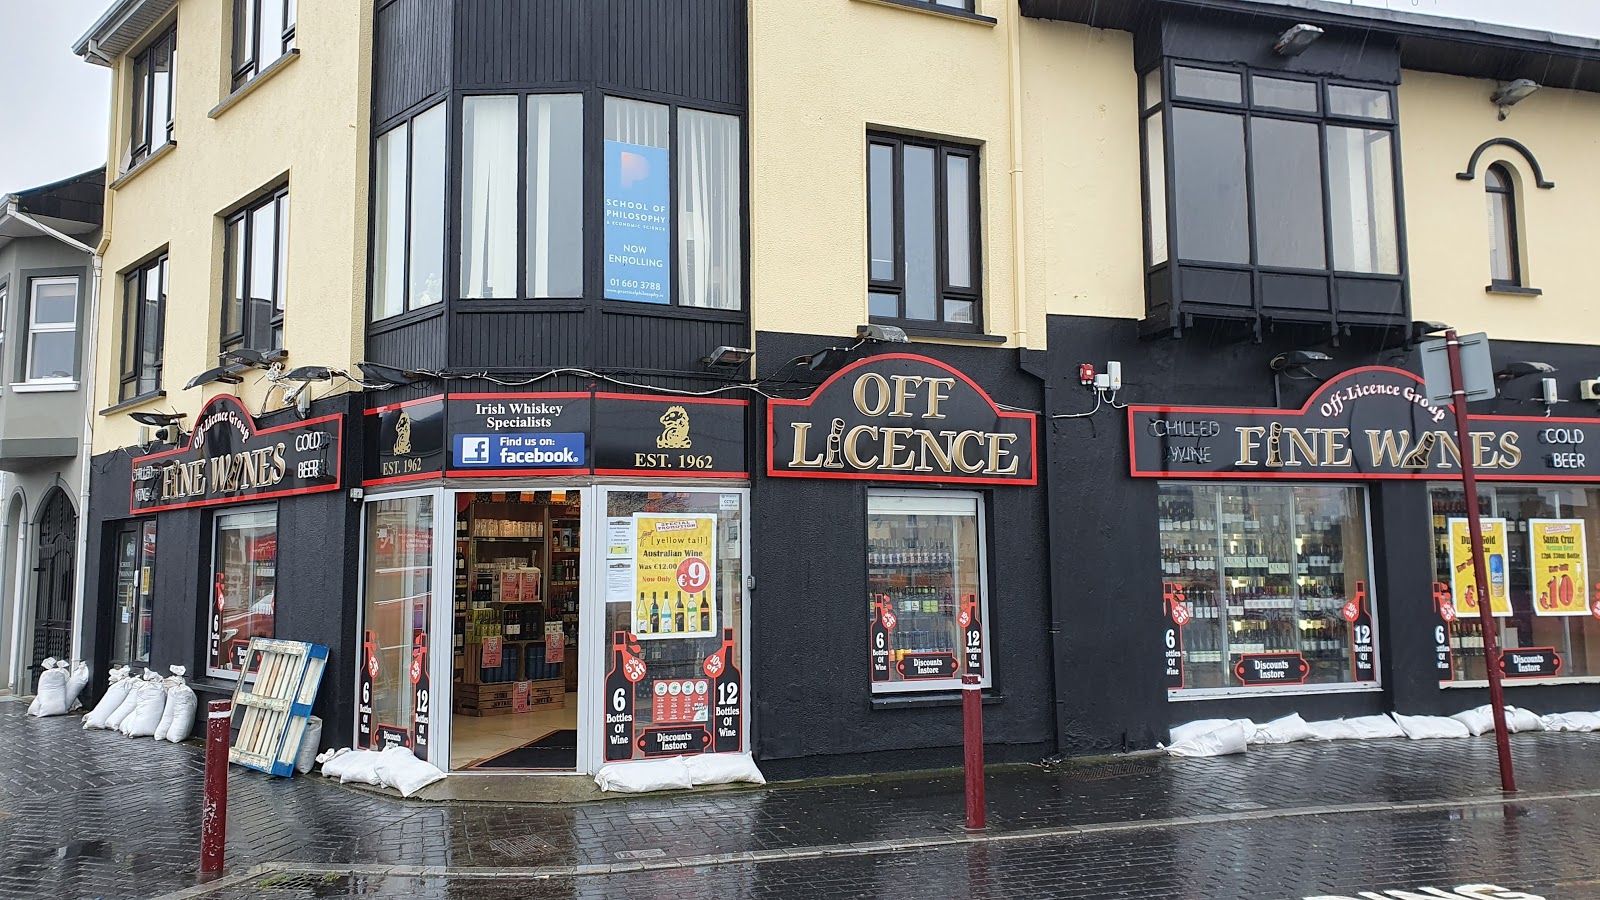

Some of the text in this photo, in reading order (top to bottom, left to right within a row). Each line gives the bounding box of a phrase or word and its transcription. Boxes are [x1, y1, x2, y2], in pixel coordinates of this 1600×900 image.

[606, 198, 648, 211] SCHOOL
[606, 209, 665, 223] PHILOSOPHY
[623, 244, 647, 254] NOW
[608, 254, 663, 268] ENROLLING
[610, 278, 661, 291] 01 660 3788
[852, 372, 956, 419] OFF
[1320, 383, 1401, 417] Off-Licence
[475, 403, 563, 416] Irish Whiskey
[194, 411, 249, 449] Off-Licence Group
[486, 417, 552, 430] Specialists
[500, 437, 555, 446] Find us on:
[1545, 428, 1584, 444] COLD
[788, 418, 1019, 475] LICENCE
[1234, 421, 1522, 469] FINE WINES
[382, 457, 422, 475] EST. 1962
[634, 453, 713, 469] EST. 1962
[1553, 453, 1586, 468] BEER
[160, 459, 206, 501] FINE
[1543, 535, 1575, 544] Santa Cruz
[684, 549, 703, 557] Wine
[213, 614, 218, 632] 6
[876, 632, 884, 648] 6
[966, 630, 980, 646] 12
[1165, 629, 1176, 649] 6
[1355, 625, 1370, 643] 12
[1435, 625, 1445, 644] 6
[873, 648, 888, 656] Bottles
[966, 646, 981, 654] Bottles
[1165, 649, 1180, 657] ottles
[1355, 644, 1372, 652] Bottles
[625, 657, 639, 673] 5%
[710, 655, 722, 668] 10%
[913, 658, 942, 667] Discounts
[1254, 660, 1289, 670] Discounts
[1357, 661, 1371, 669] Wine
[1513, 654, 1544, 664] Discounts
[631, 663, 645, 679] off
[707, 664, 718, 674] off
[918, 666, 939, 674] Instore
[1260, 669, 1285, 679] Instore
[1518, 663, 1541, 672] Instore
[363, 682, 369, 703] 6
[717, 682, 738, 705] 12
[417, 689, 428, 712] 12
[613, 687, 626, 712] 6
[606, 712, 632, 723] Bottles
[716, 706, 740, 716] Bottles
[723, 716, 732, 726] Of
[615, 724, 624, 733] Of
[718, 727, 736, 737] Wine
[610, 735, 628, 745] Wine
[657, 732, 692, 743] Discounts
[662, 741, 687, 750] Instore
